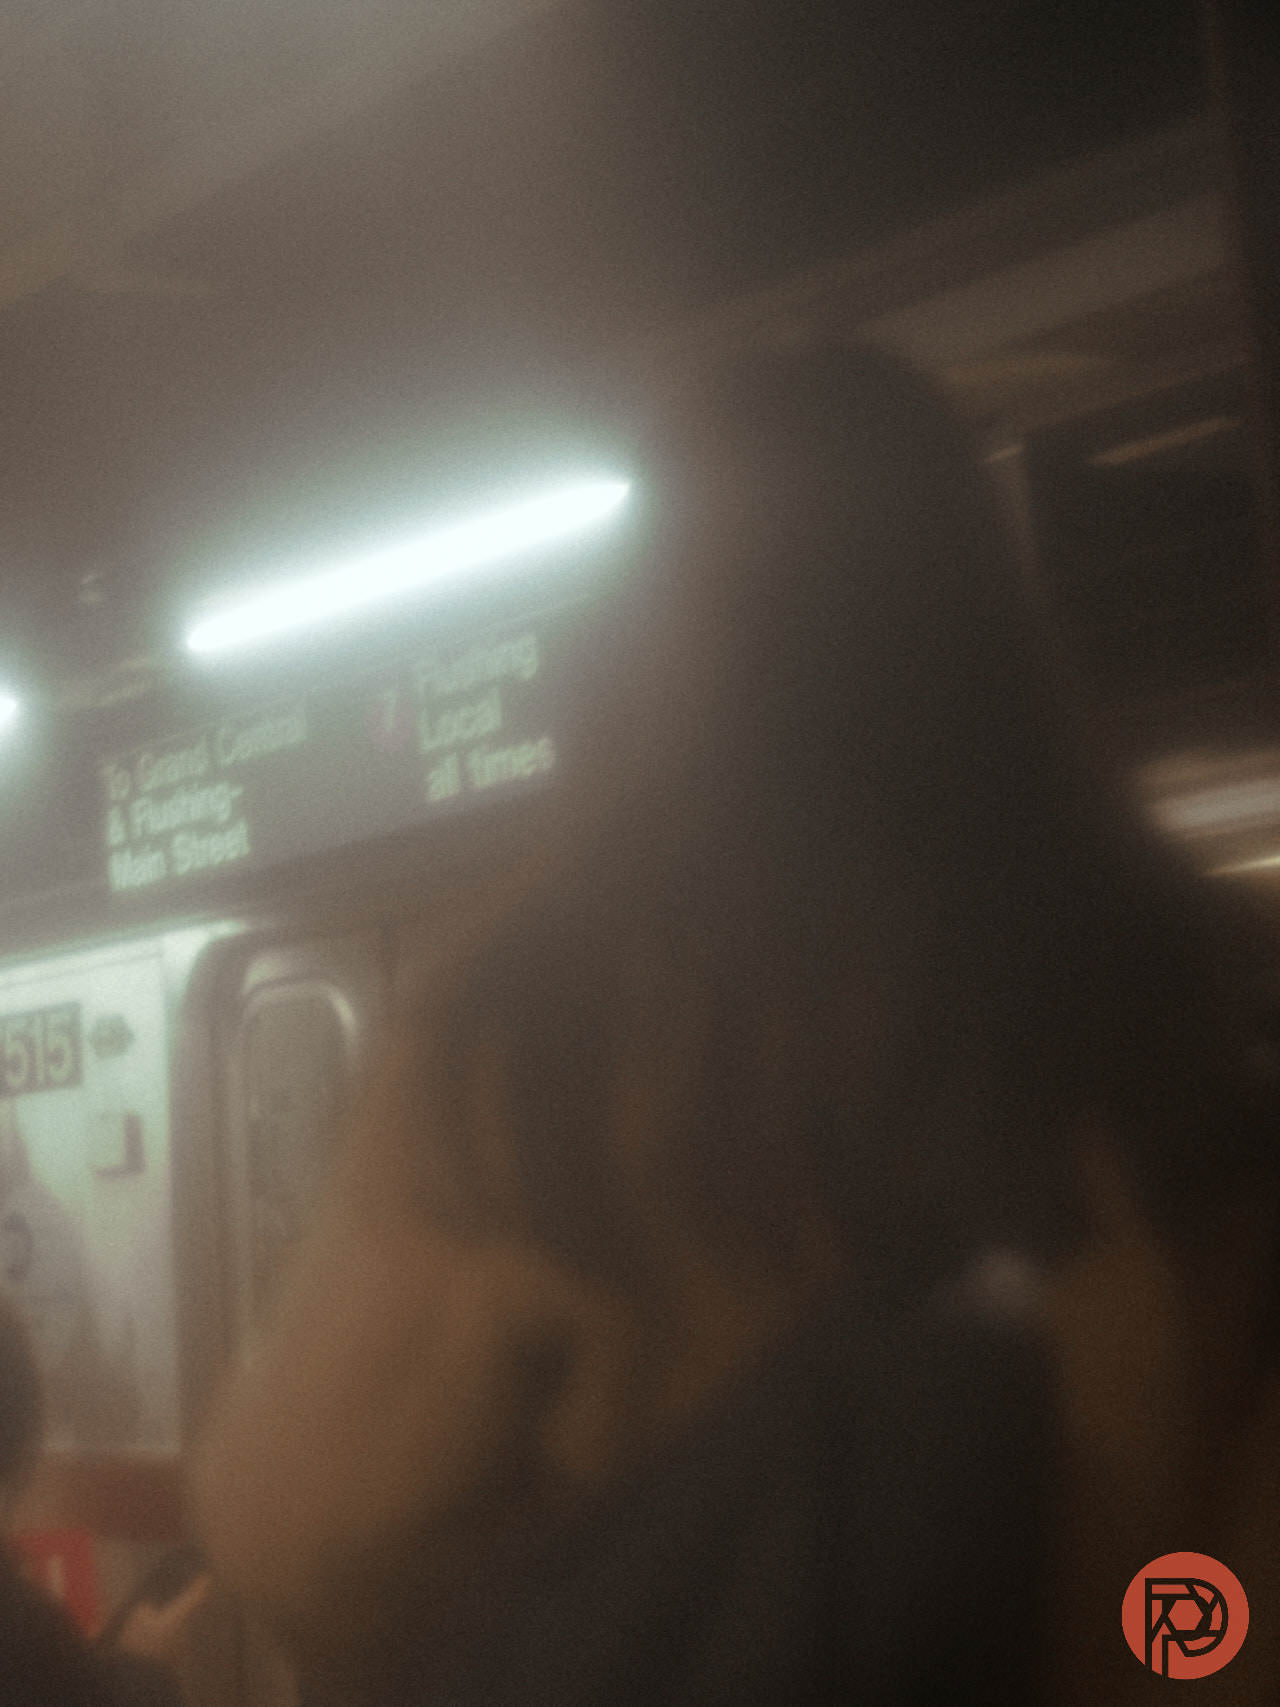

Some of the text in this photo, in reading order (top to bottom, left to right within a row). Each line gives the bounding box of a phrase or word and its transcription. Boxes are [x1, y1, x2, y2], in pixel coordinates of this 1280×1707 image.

[100, 698, 309, 802] To Grand Central
[417, 684, 504, 755] Local
[424, 734, 556, 804] all times
[107, 814, 251, 893] Main Street
